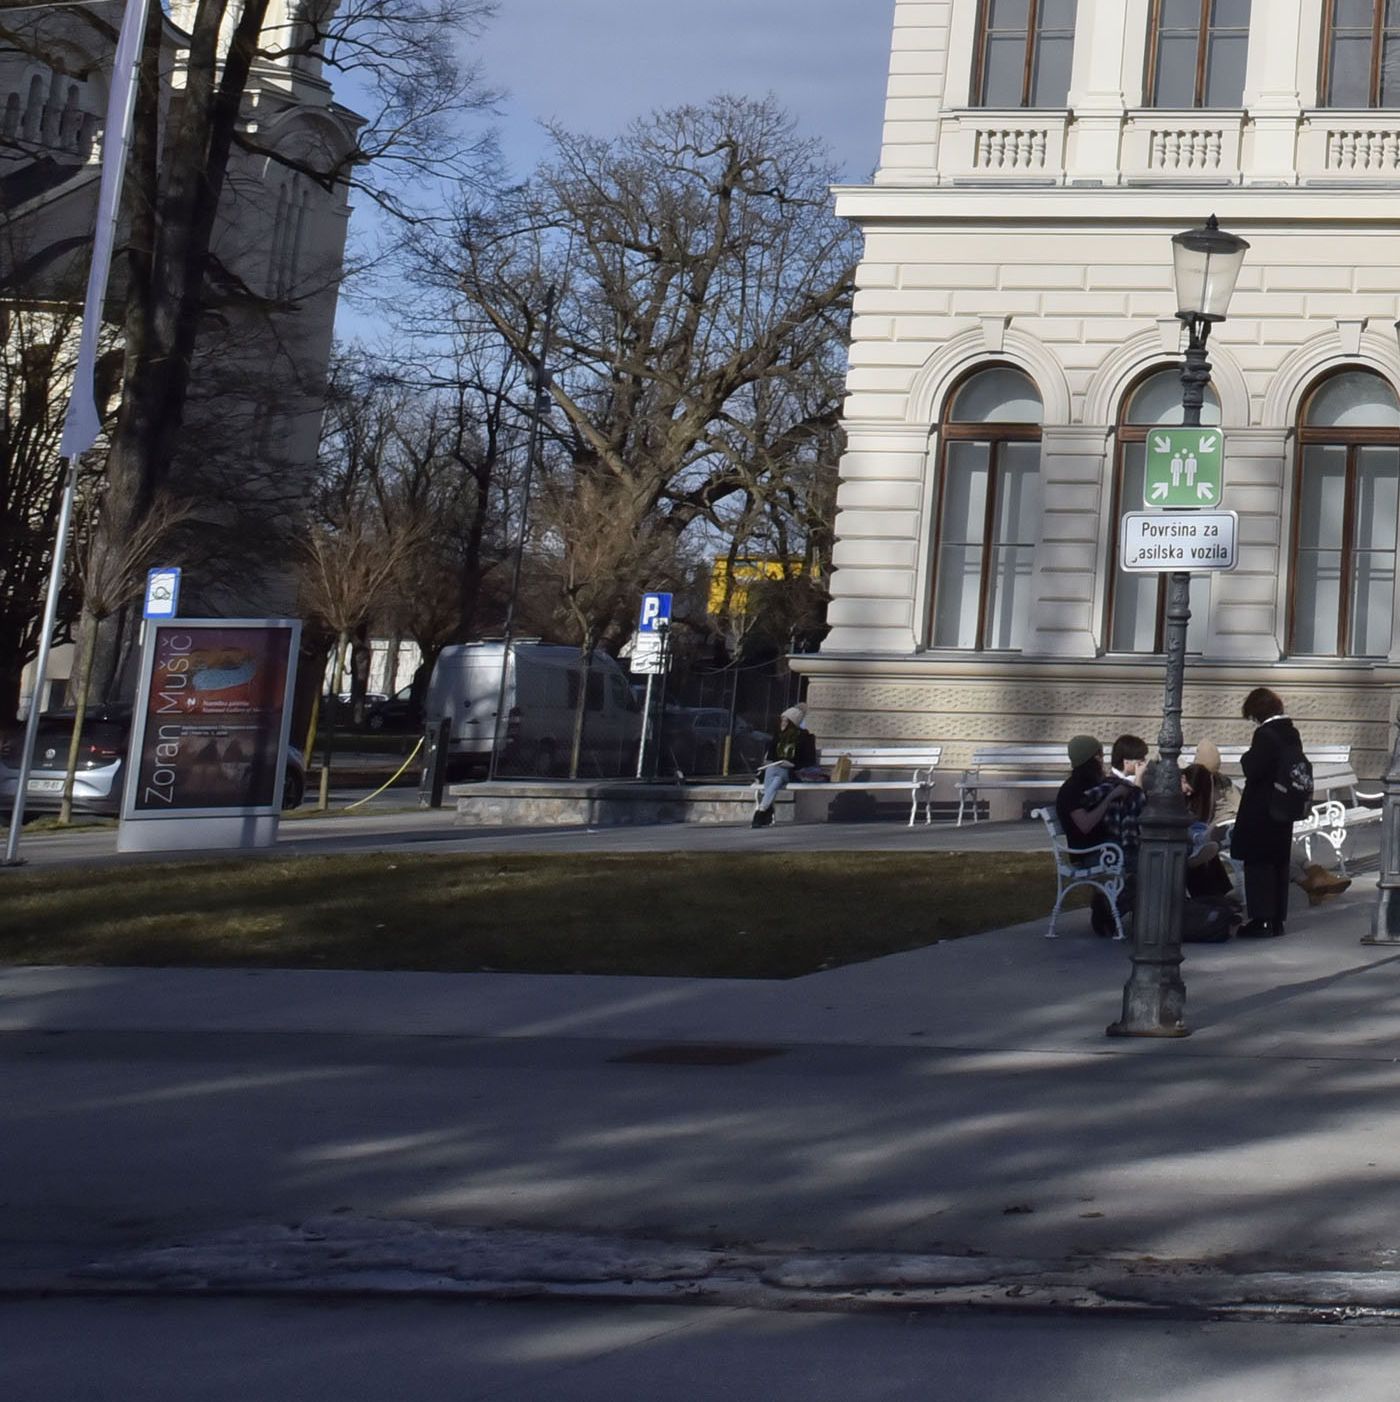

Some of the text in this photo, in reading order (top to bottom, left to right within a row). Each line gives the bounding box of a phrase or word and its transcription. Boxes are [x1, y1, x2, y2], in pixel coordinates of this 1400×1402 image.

[1141, 521, 1219, 537] Površina za
[1131, 543, 1228, 563] asilska vozila
[642, 596, 660, 626] P
[144, 724, 182, 804] Zoran
